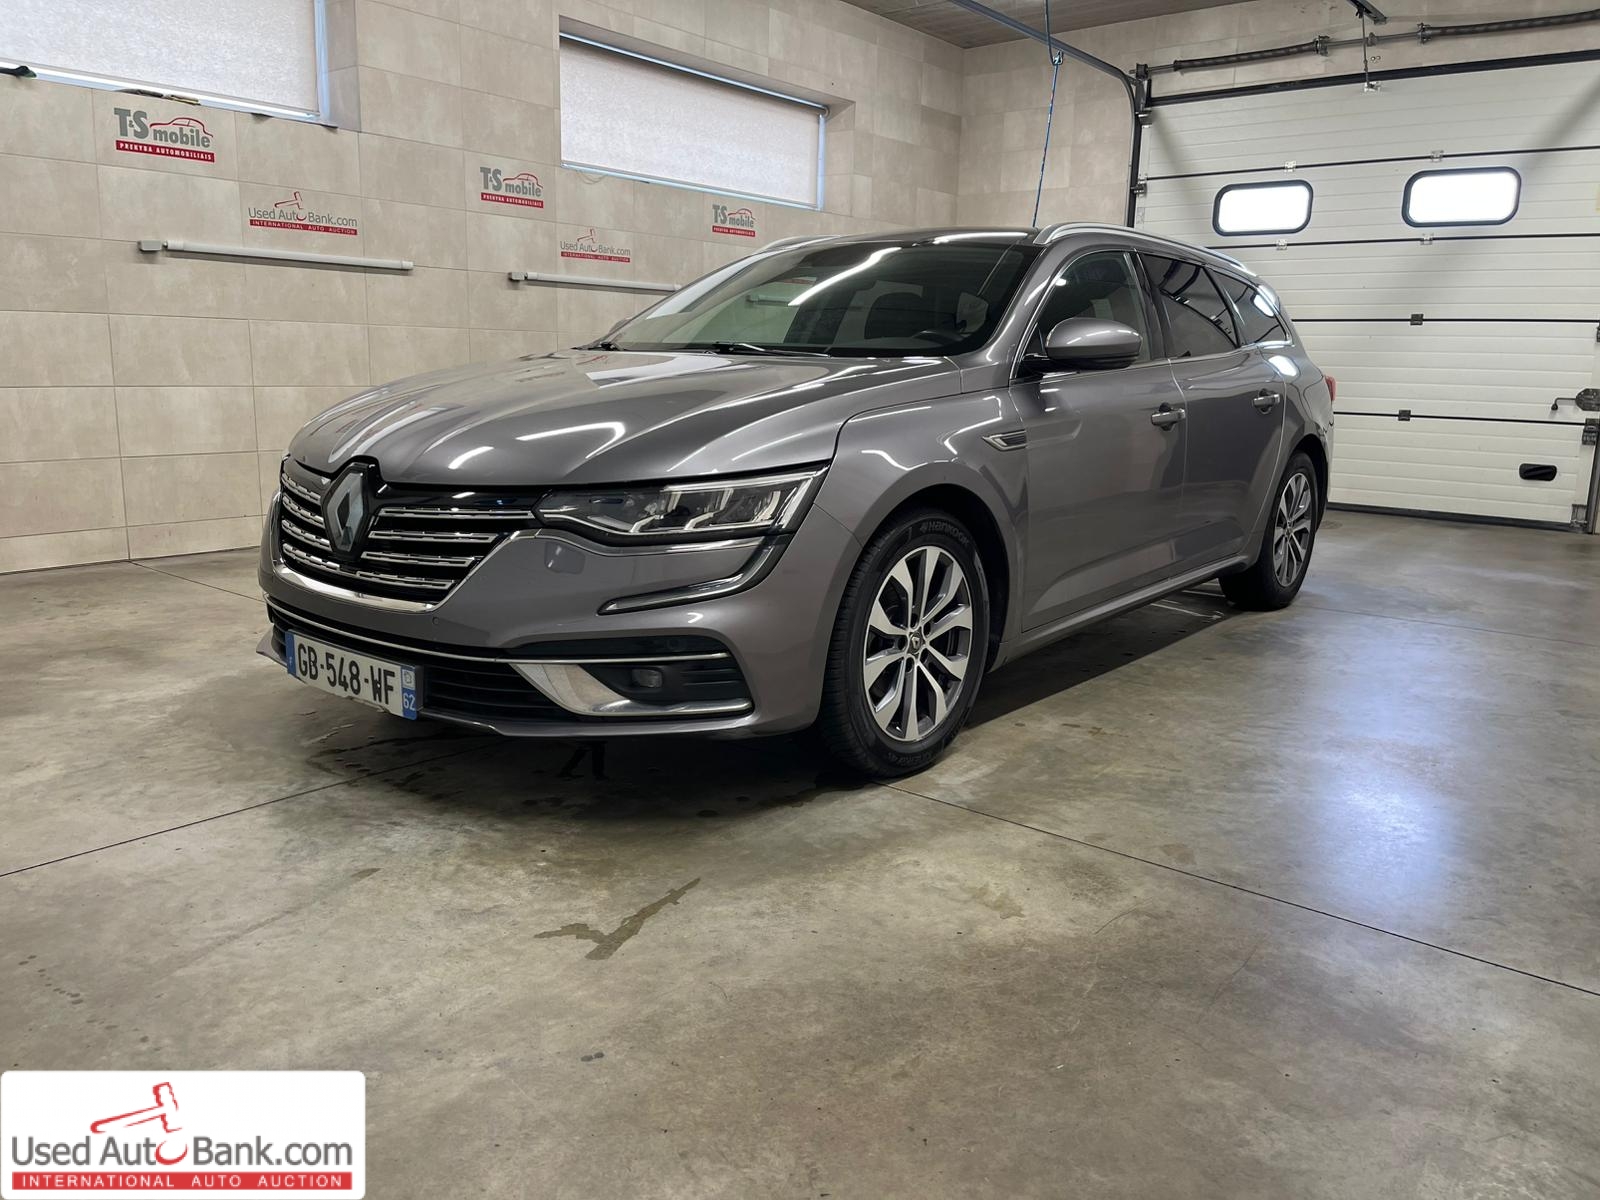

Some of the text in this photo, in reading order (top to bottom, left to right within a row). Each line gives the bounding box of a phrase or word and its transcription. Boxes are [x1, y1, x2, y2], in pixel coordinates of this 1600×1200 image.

[153, 127, 211, 148] mobile
[156, 147, 213, 161] AUTOMOBILIAIS
[505, 181, 542, 197] mobile
[248, 207, 276, 220] Used
[252, 220, 304, 230] INTERNATIONAL
[728, 215, 754, 228] mobile
[297, 643, 396, 705] GB-548-WF
[403, 692, 416, 712] 62
